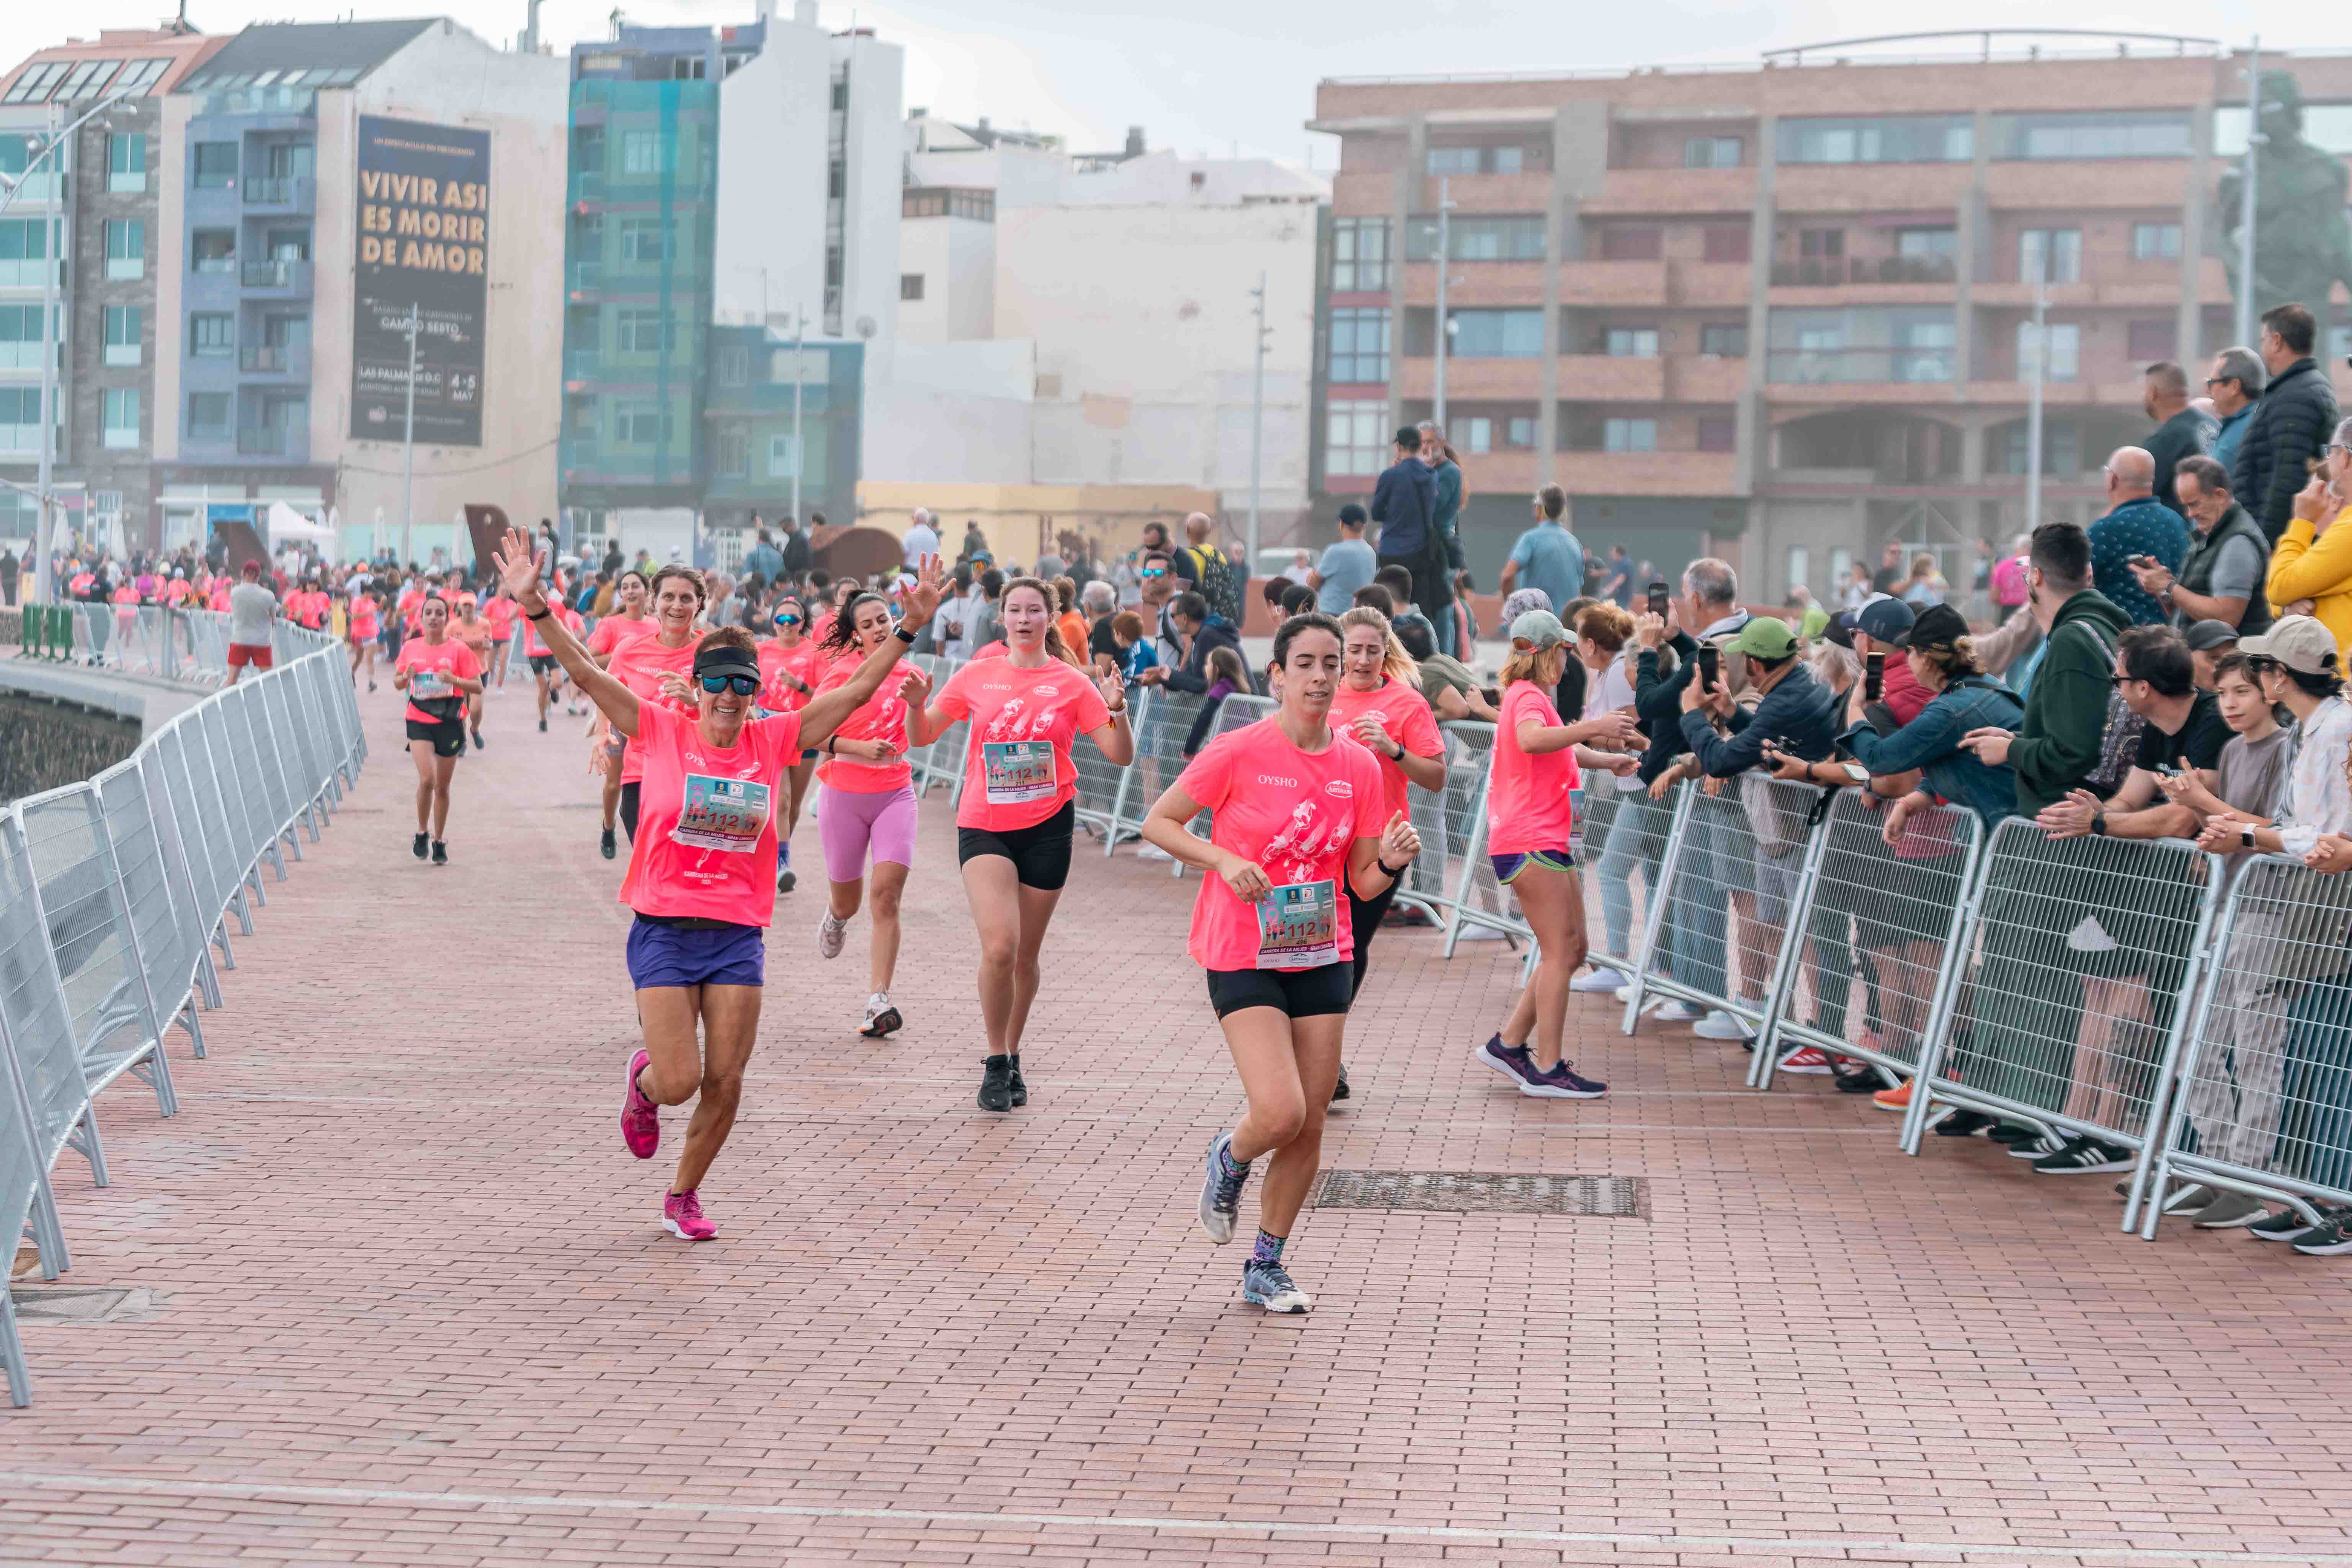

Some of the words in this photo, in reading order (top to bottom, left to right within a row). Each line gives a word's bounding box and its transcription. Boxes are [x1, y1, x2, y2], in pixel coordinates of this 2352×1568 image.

[361, 169, 438, 206] VIVIR
[443, 181, 486, 211] ASI
[362, 204, 391, 233] ES
[397, 209, 485, 243] MORIR
[361, 235, 397, 266] DE
[402, 240, 484, 273] AMOR
[983, 683, 1011, 691] OYSHO
[1008, 768, 1032, 779] 112
[1258, 774, 1298, 787] OYSHO
[709, 812, 739, 827] 112
[1288, 922, 1316, 938] 112
